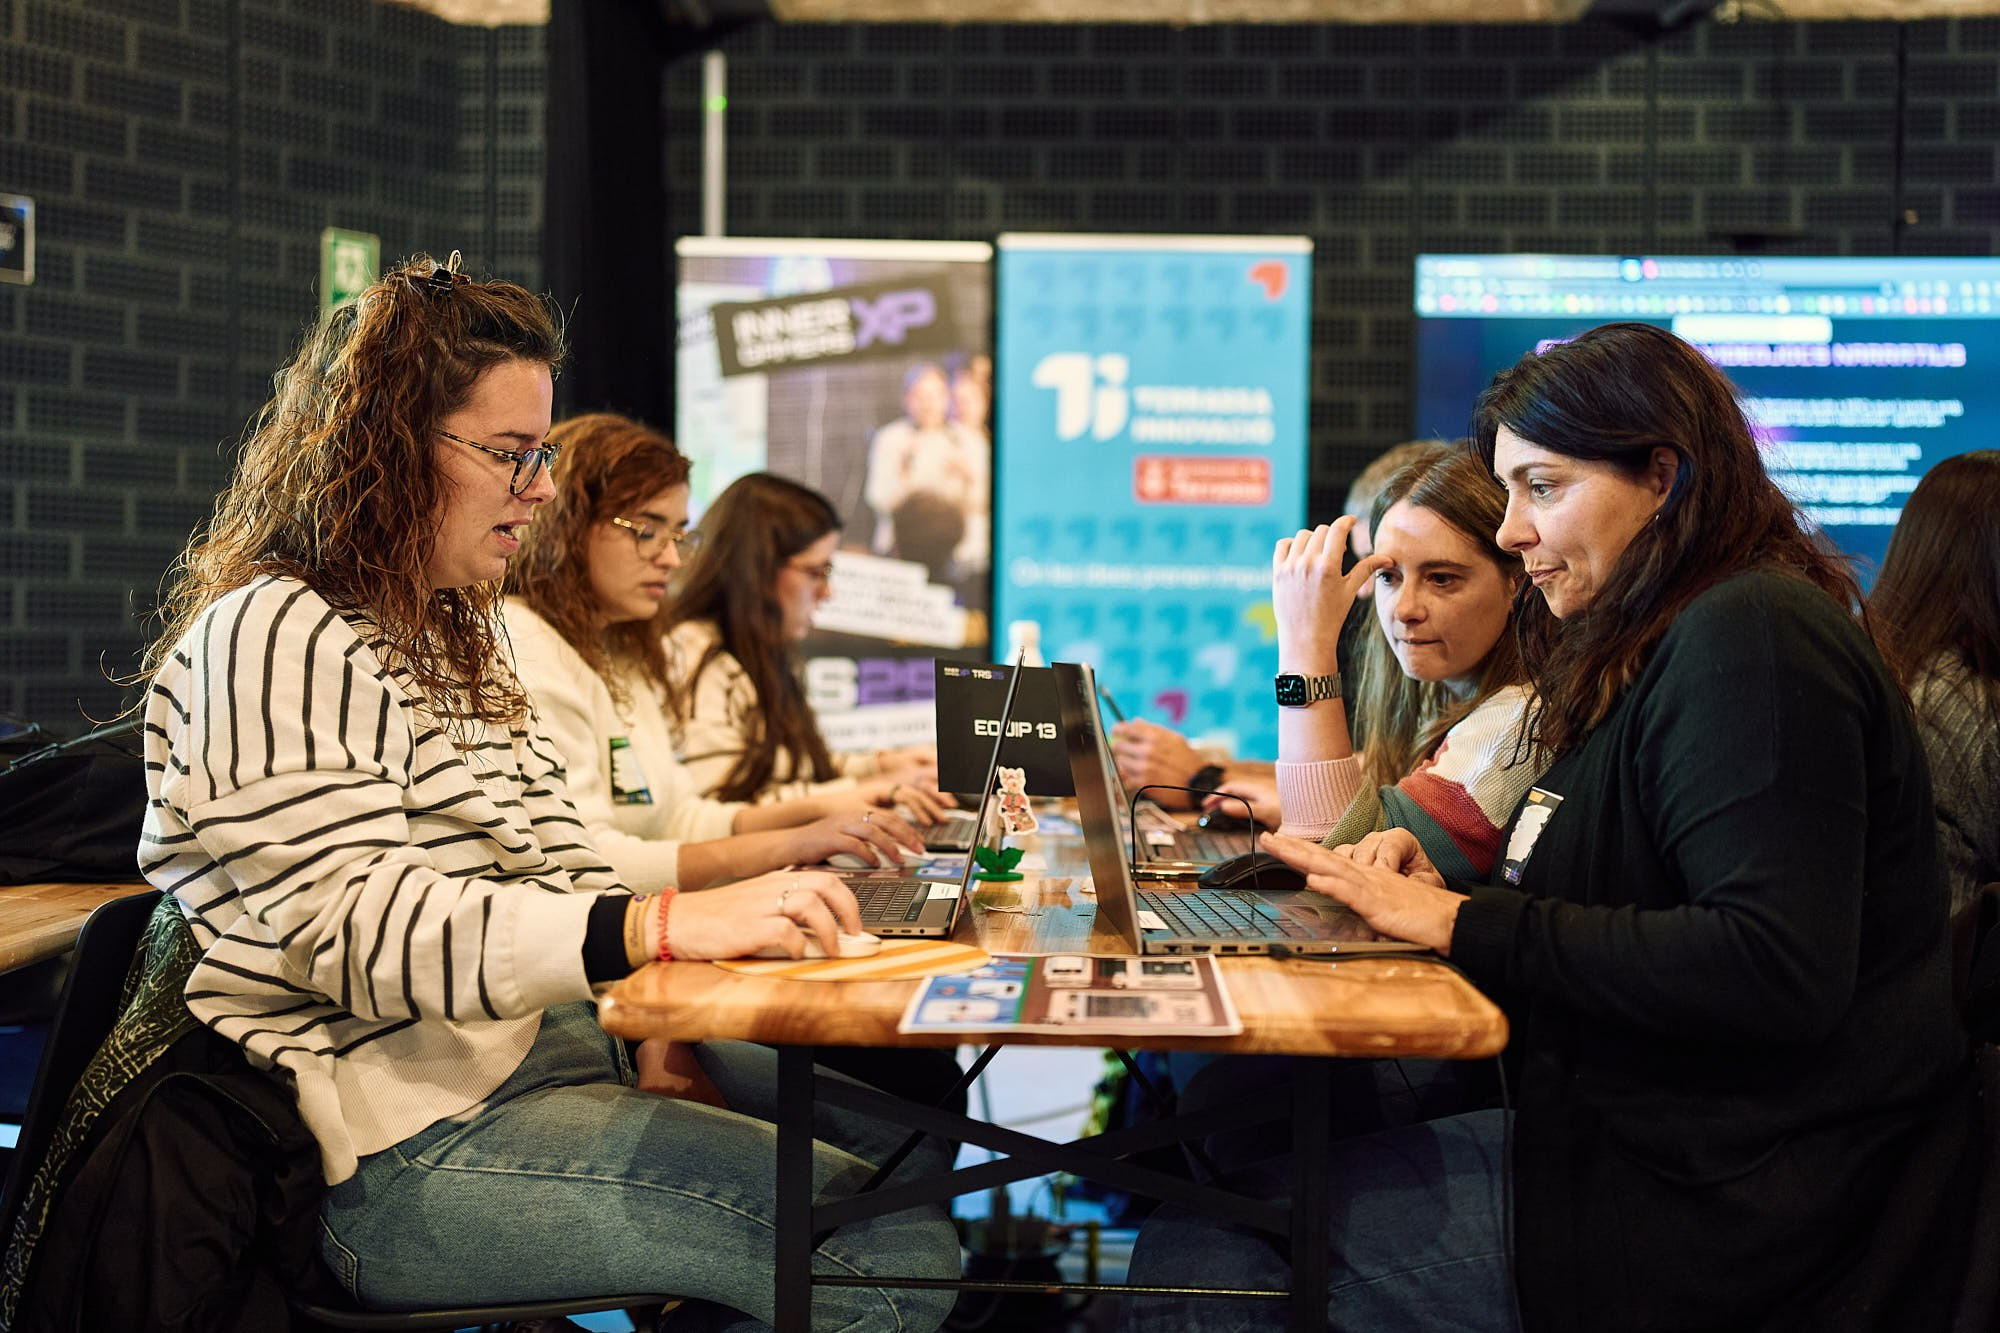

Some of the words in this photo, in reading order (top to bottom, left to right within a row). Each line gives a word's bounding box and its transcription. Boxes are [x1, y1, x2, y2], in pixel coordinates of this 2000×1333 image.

[849, 290, 936, 349] XP
[804, 657, 935, 710] S25
[1035, 722, 1057, 739] 13
